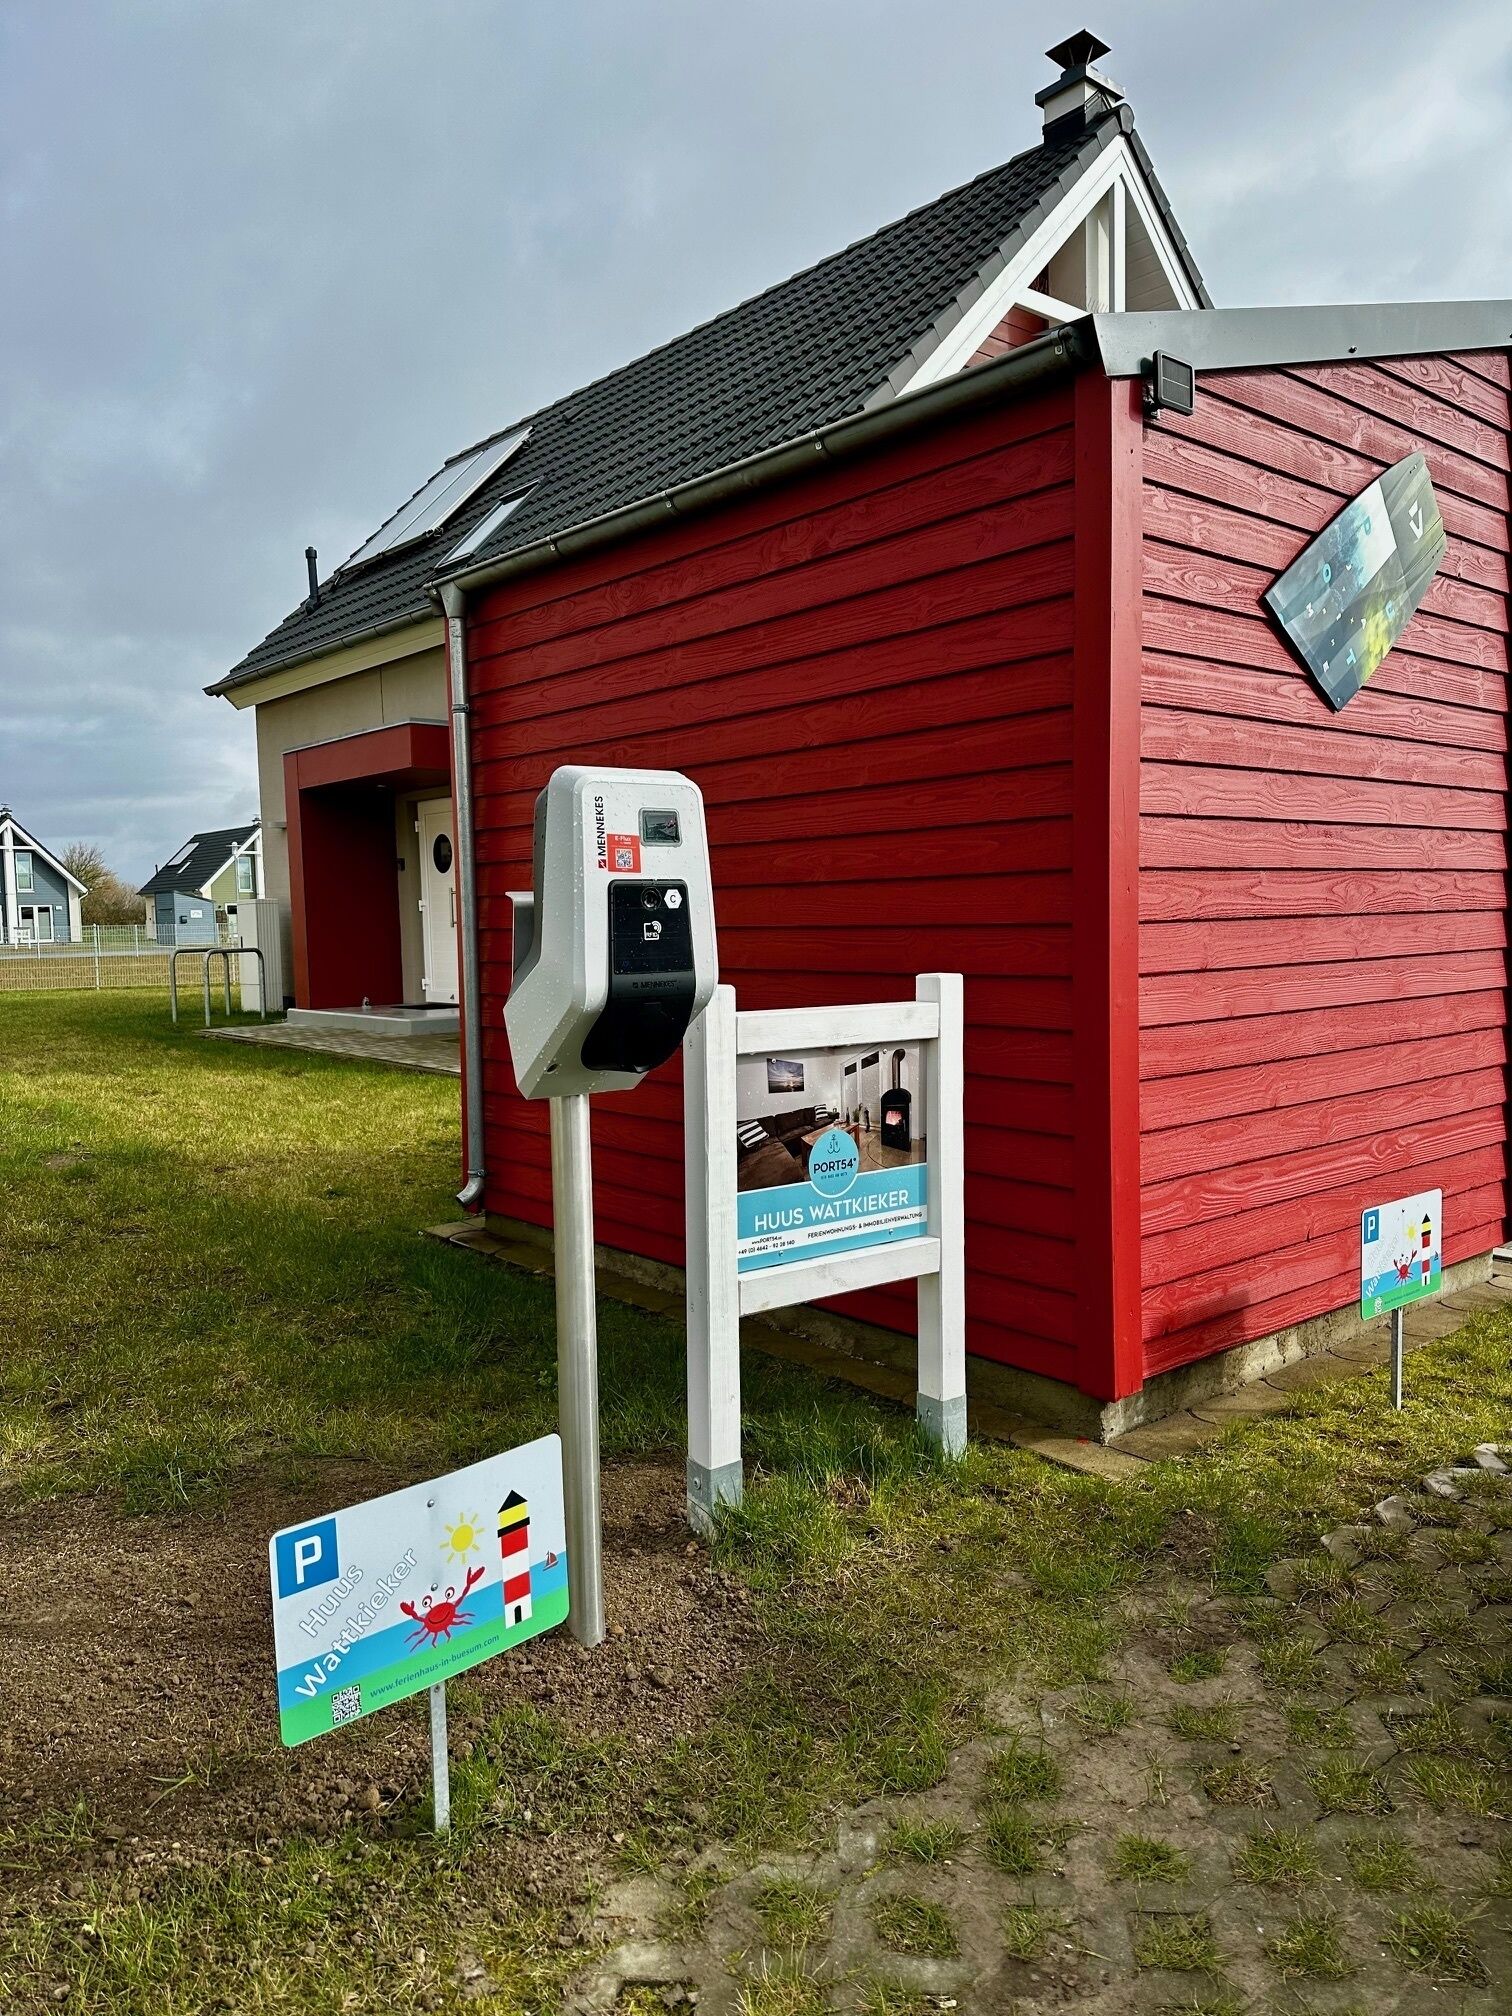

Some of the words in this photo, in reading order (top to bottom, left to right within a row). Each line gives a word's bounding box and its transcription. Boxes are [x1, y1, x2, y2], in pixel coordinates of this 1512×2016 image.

[595, 795, 607, 856] MENNEKES
[669, 894, 677, 903] C
[754, 1208, 804, 1232] HUUS
[808, 1189, 909, 1221] WATTKIEKER
[807, 1225, 858, 1239] FERIENWOHNUNGS-
[862, 1211, 923, 1228] IMMOBILIENVERWALTUNG
[1367, 1215, 1376, 1240] P
[294, 1535, 322, 1585] P
[295, 1548, 419, 1698] Wattkieker
[299, 1563, 364, 1638] Huus
[369, 1635, 500, 1698] www.ferienhaus-in-buesum.com
